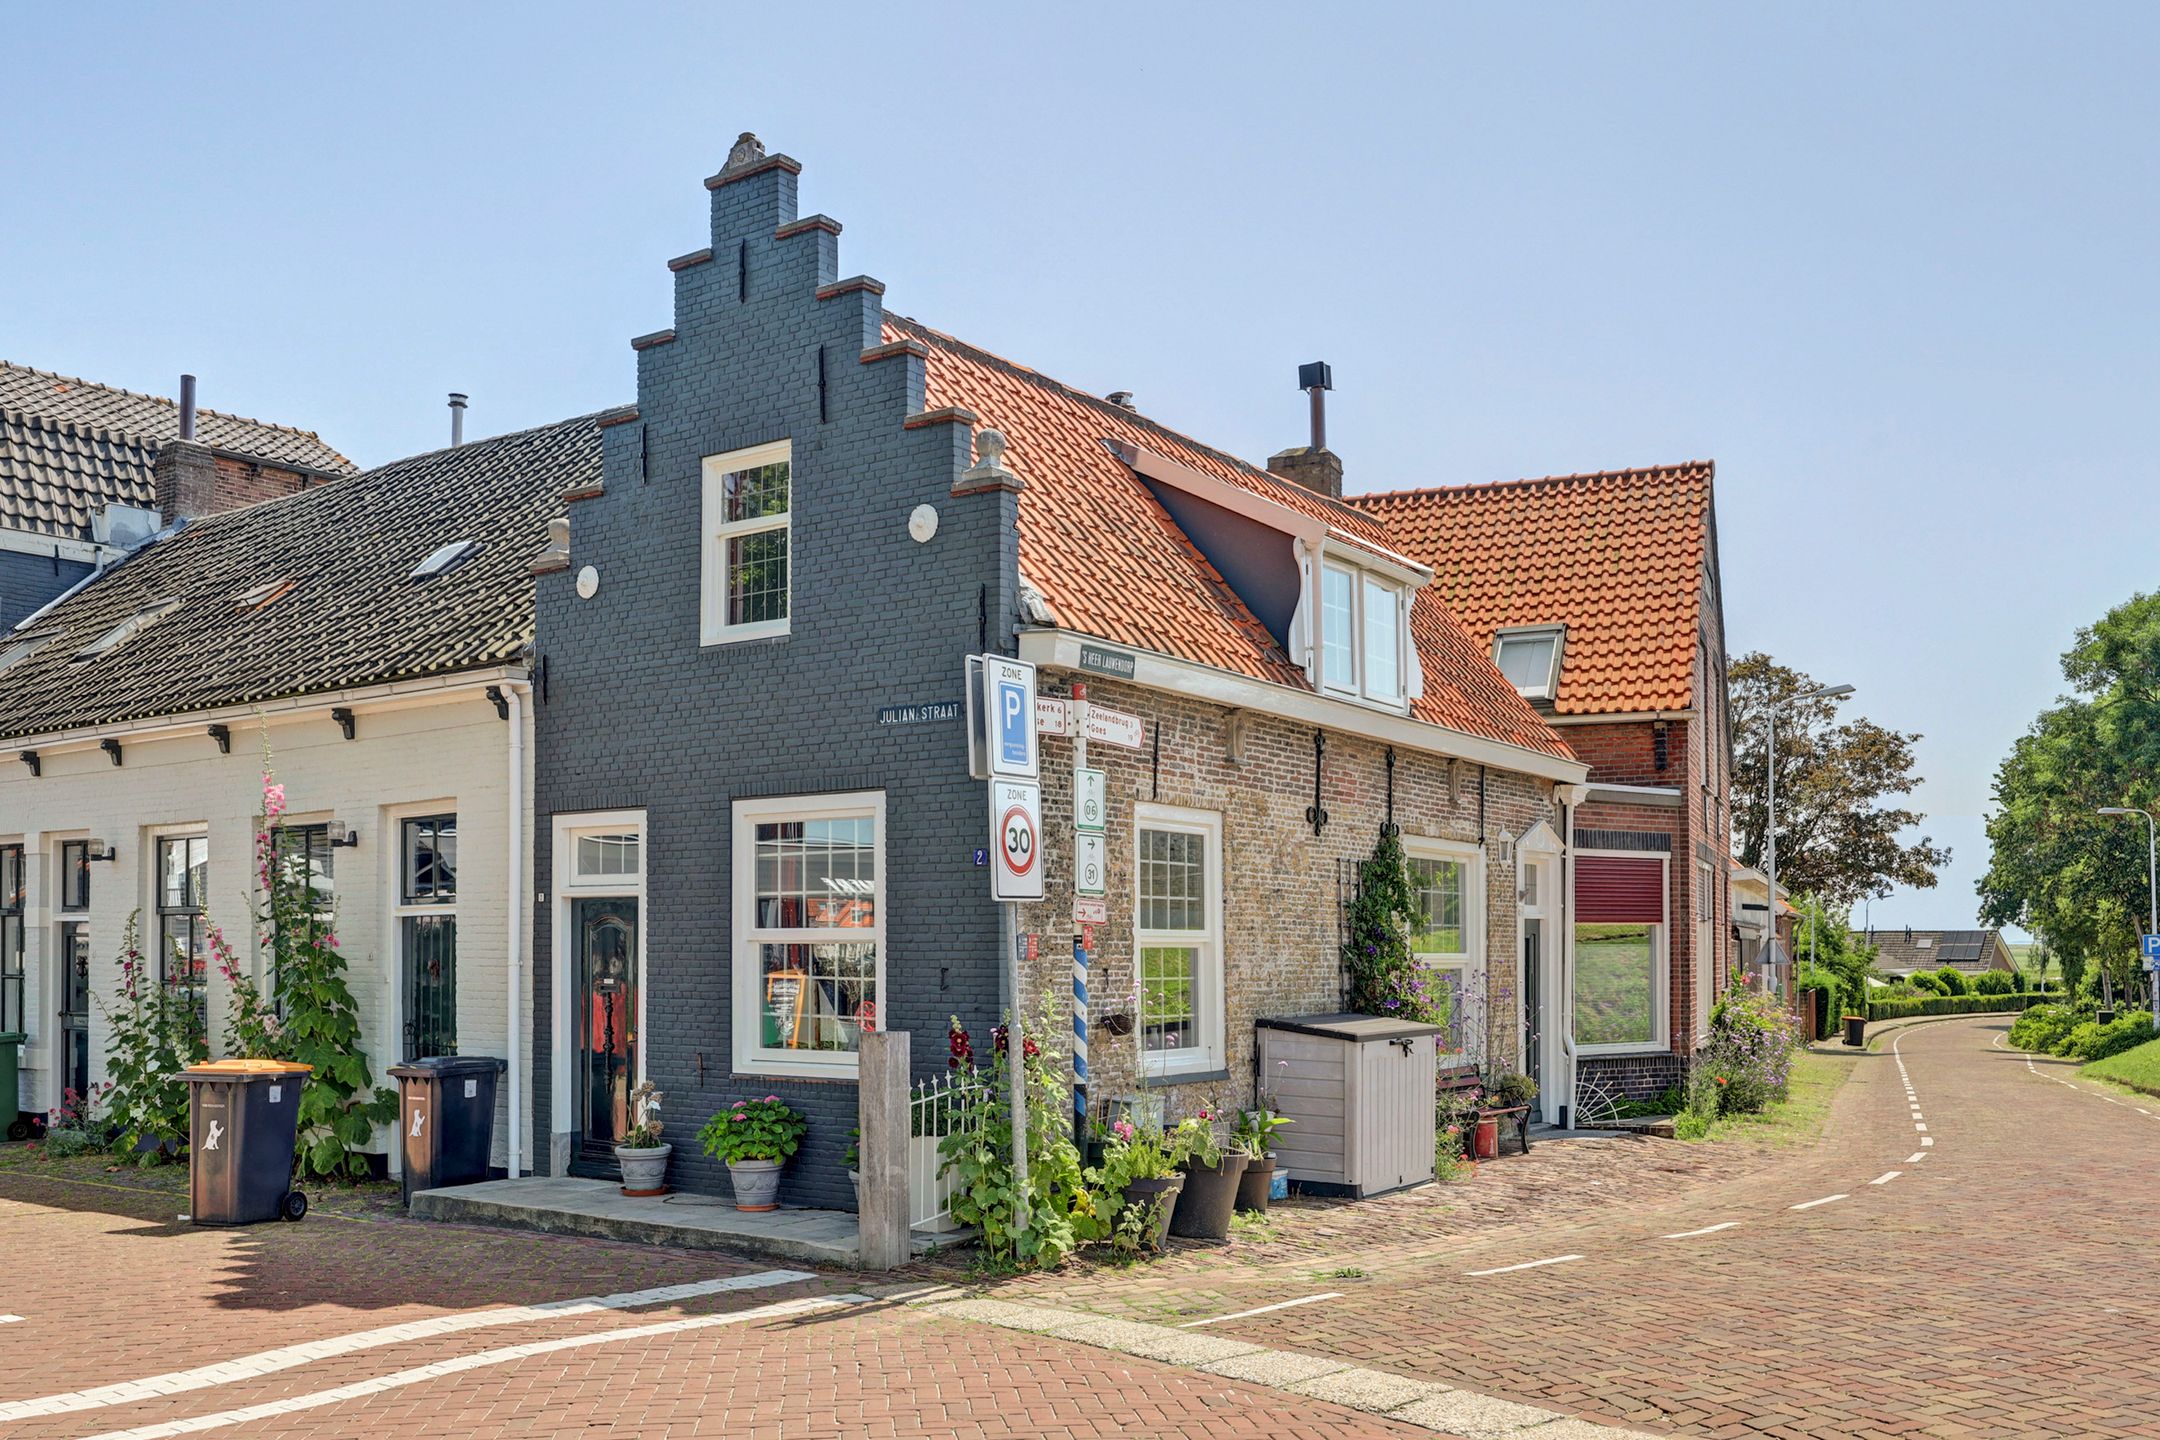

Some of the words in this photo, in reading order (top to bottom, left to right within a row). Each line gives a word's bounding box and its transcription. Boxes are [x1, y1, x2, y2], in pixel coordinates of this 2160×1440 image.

[1001, 666, 1022, 680] ZONE
[880, 703, 959, 724] JULIANSTRAAT
[1005, 690, 1021, 730] P
[1036, 702, 1055, 713] kerk
[1057, 706, 1062, 714] 6
[1054, 720, 1062, 728] 18
[1091, 709, 1129, 729] Zeelandbrug
[1091, 723, 1106, 735] Goes
[1007, 788, 1028, 801] ZONE
[1085, 805, 1096, 815] 06
[1008, 827, 1030, 854] 30
[976, 850, 983, 865] 2
[1087, 869, 1095, 880] 31
[2148, 936, 2160, 954] P
